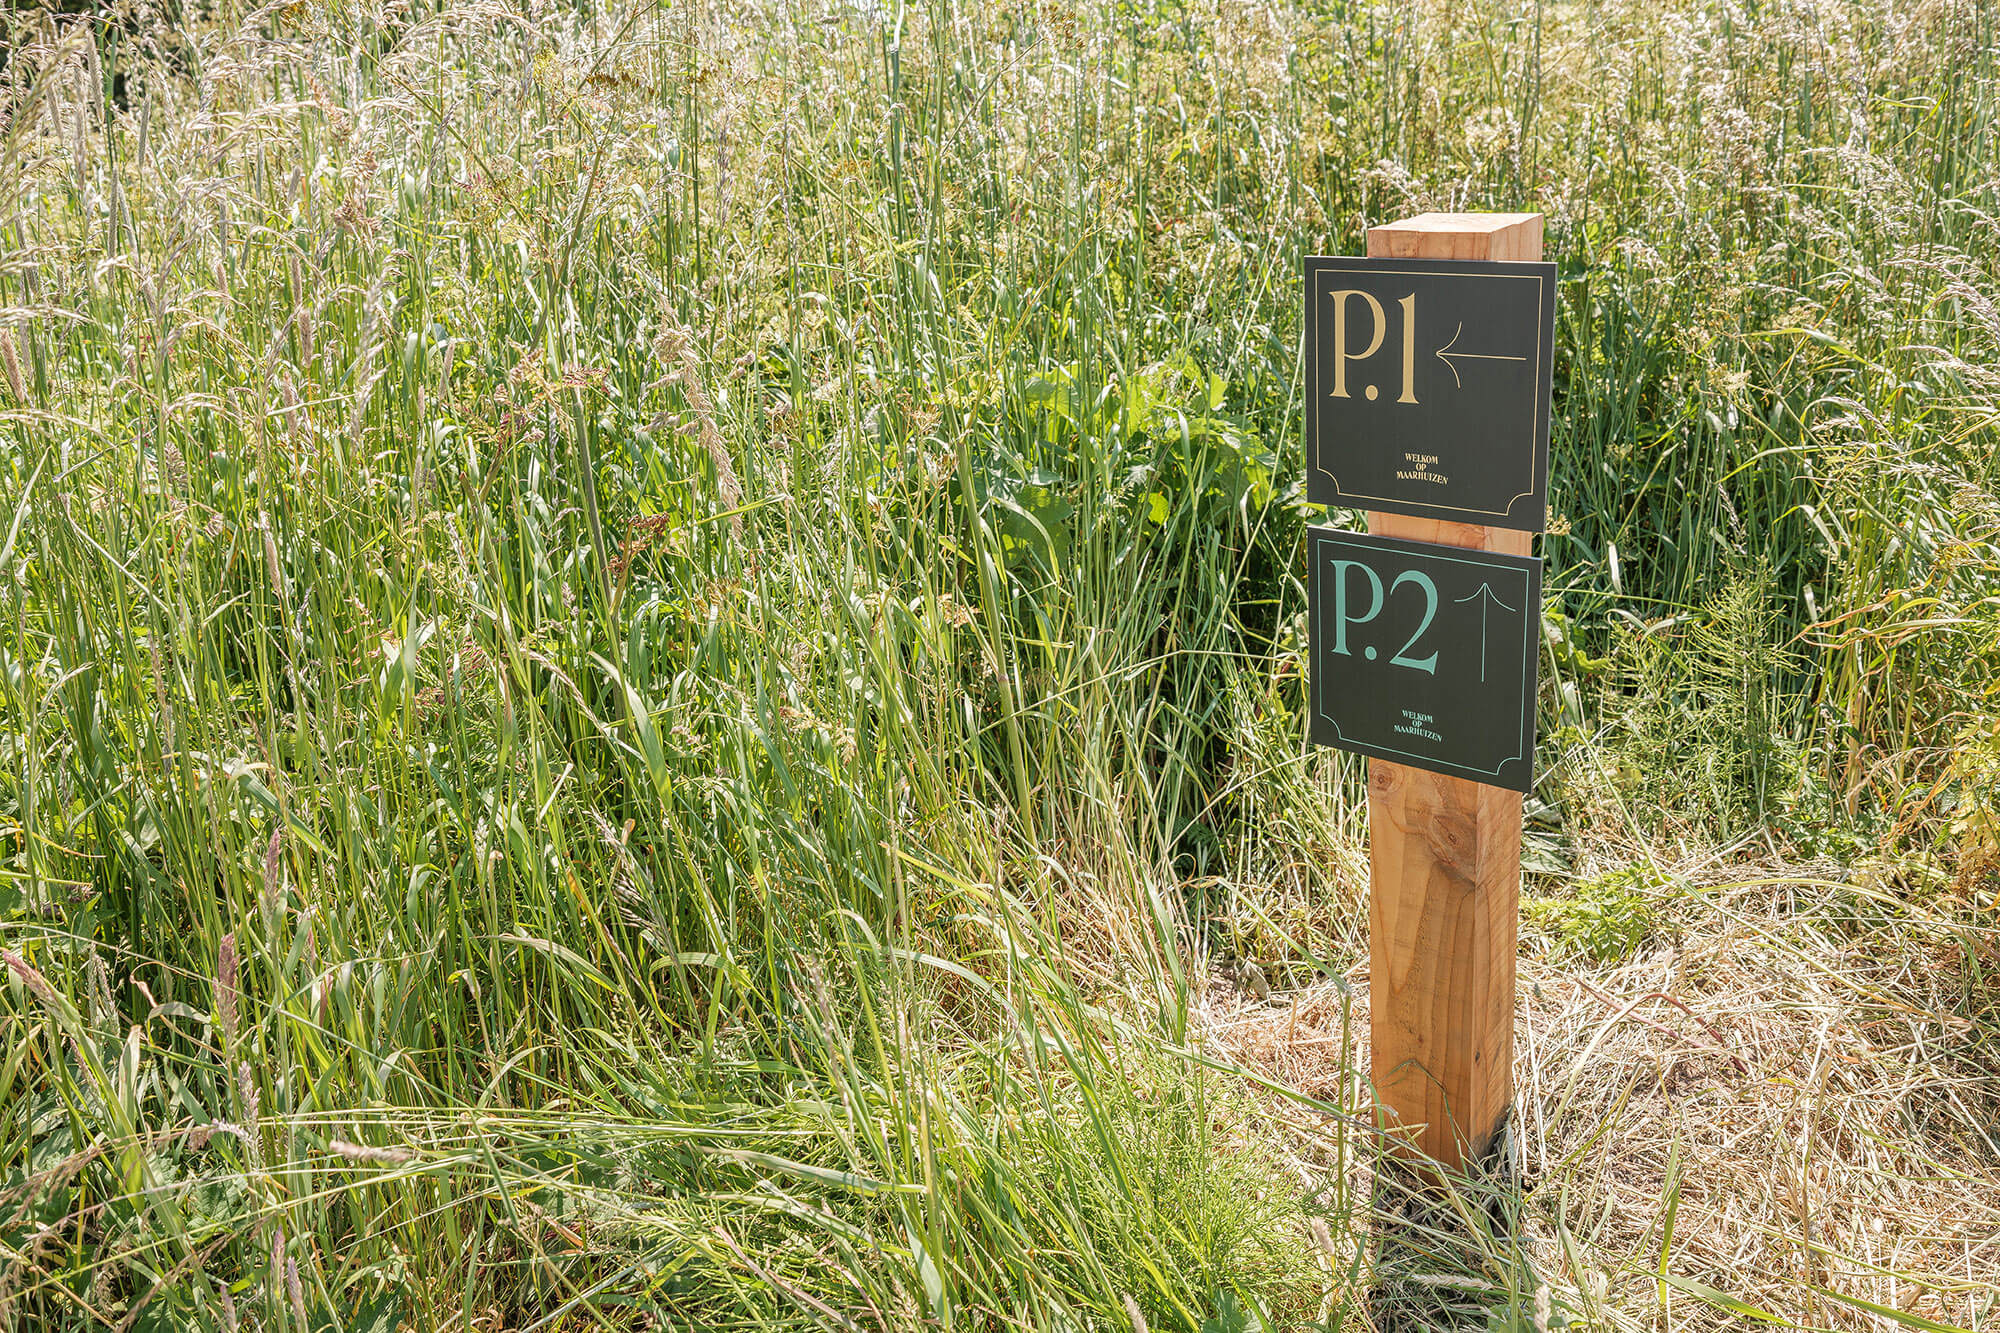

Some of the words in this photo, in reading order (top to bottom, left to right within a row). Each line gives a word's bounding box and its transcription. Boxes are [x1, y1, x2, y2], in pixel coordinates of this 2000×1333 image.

[1328, 289, 1421, 405] P.1
[1405, 452, 1439, 464] WELKOM
[1415, 463, 1427, 471] OP
[1397, 471, 1449, 485] MAARHUIZEN
[1329, 559, 1439, 676] P.2
[1402, 709, 1433, 723] WELKOM
[1412, 720, 1423, 728] OP
[1394, 724, 1443, 742] MAARHUIZEN
